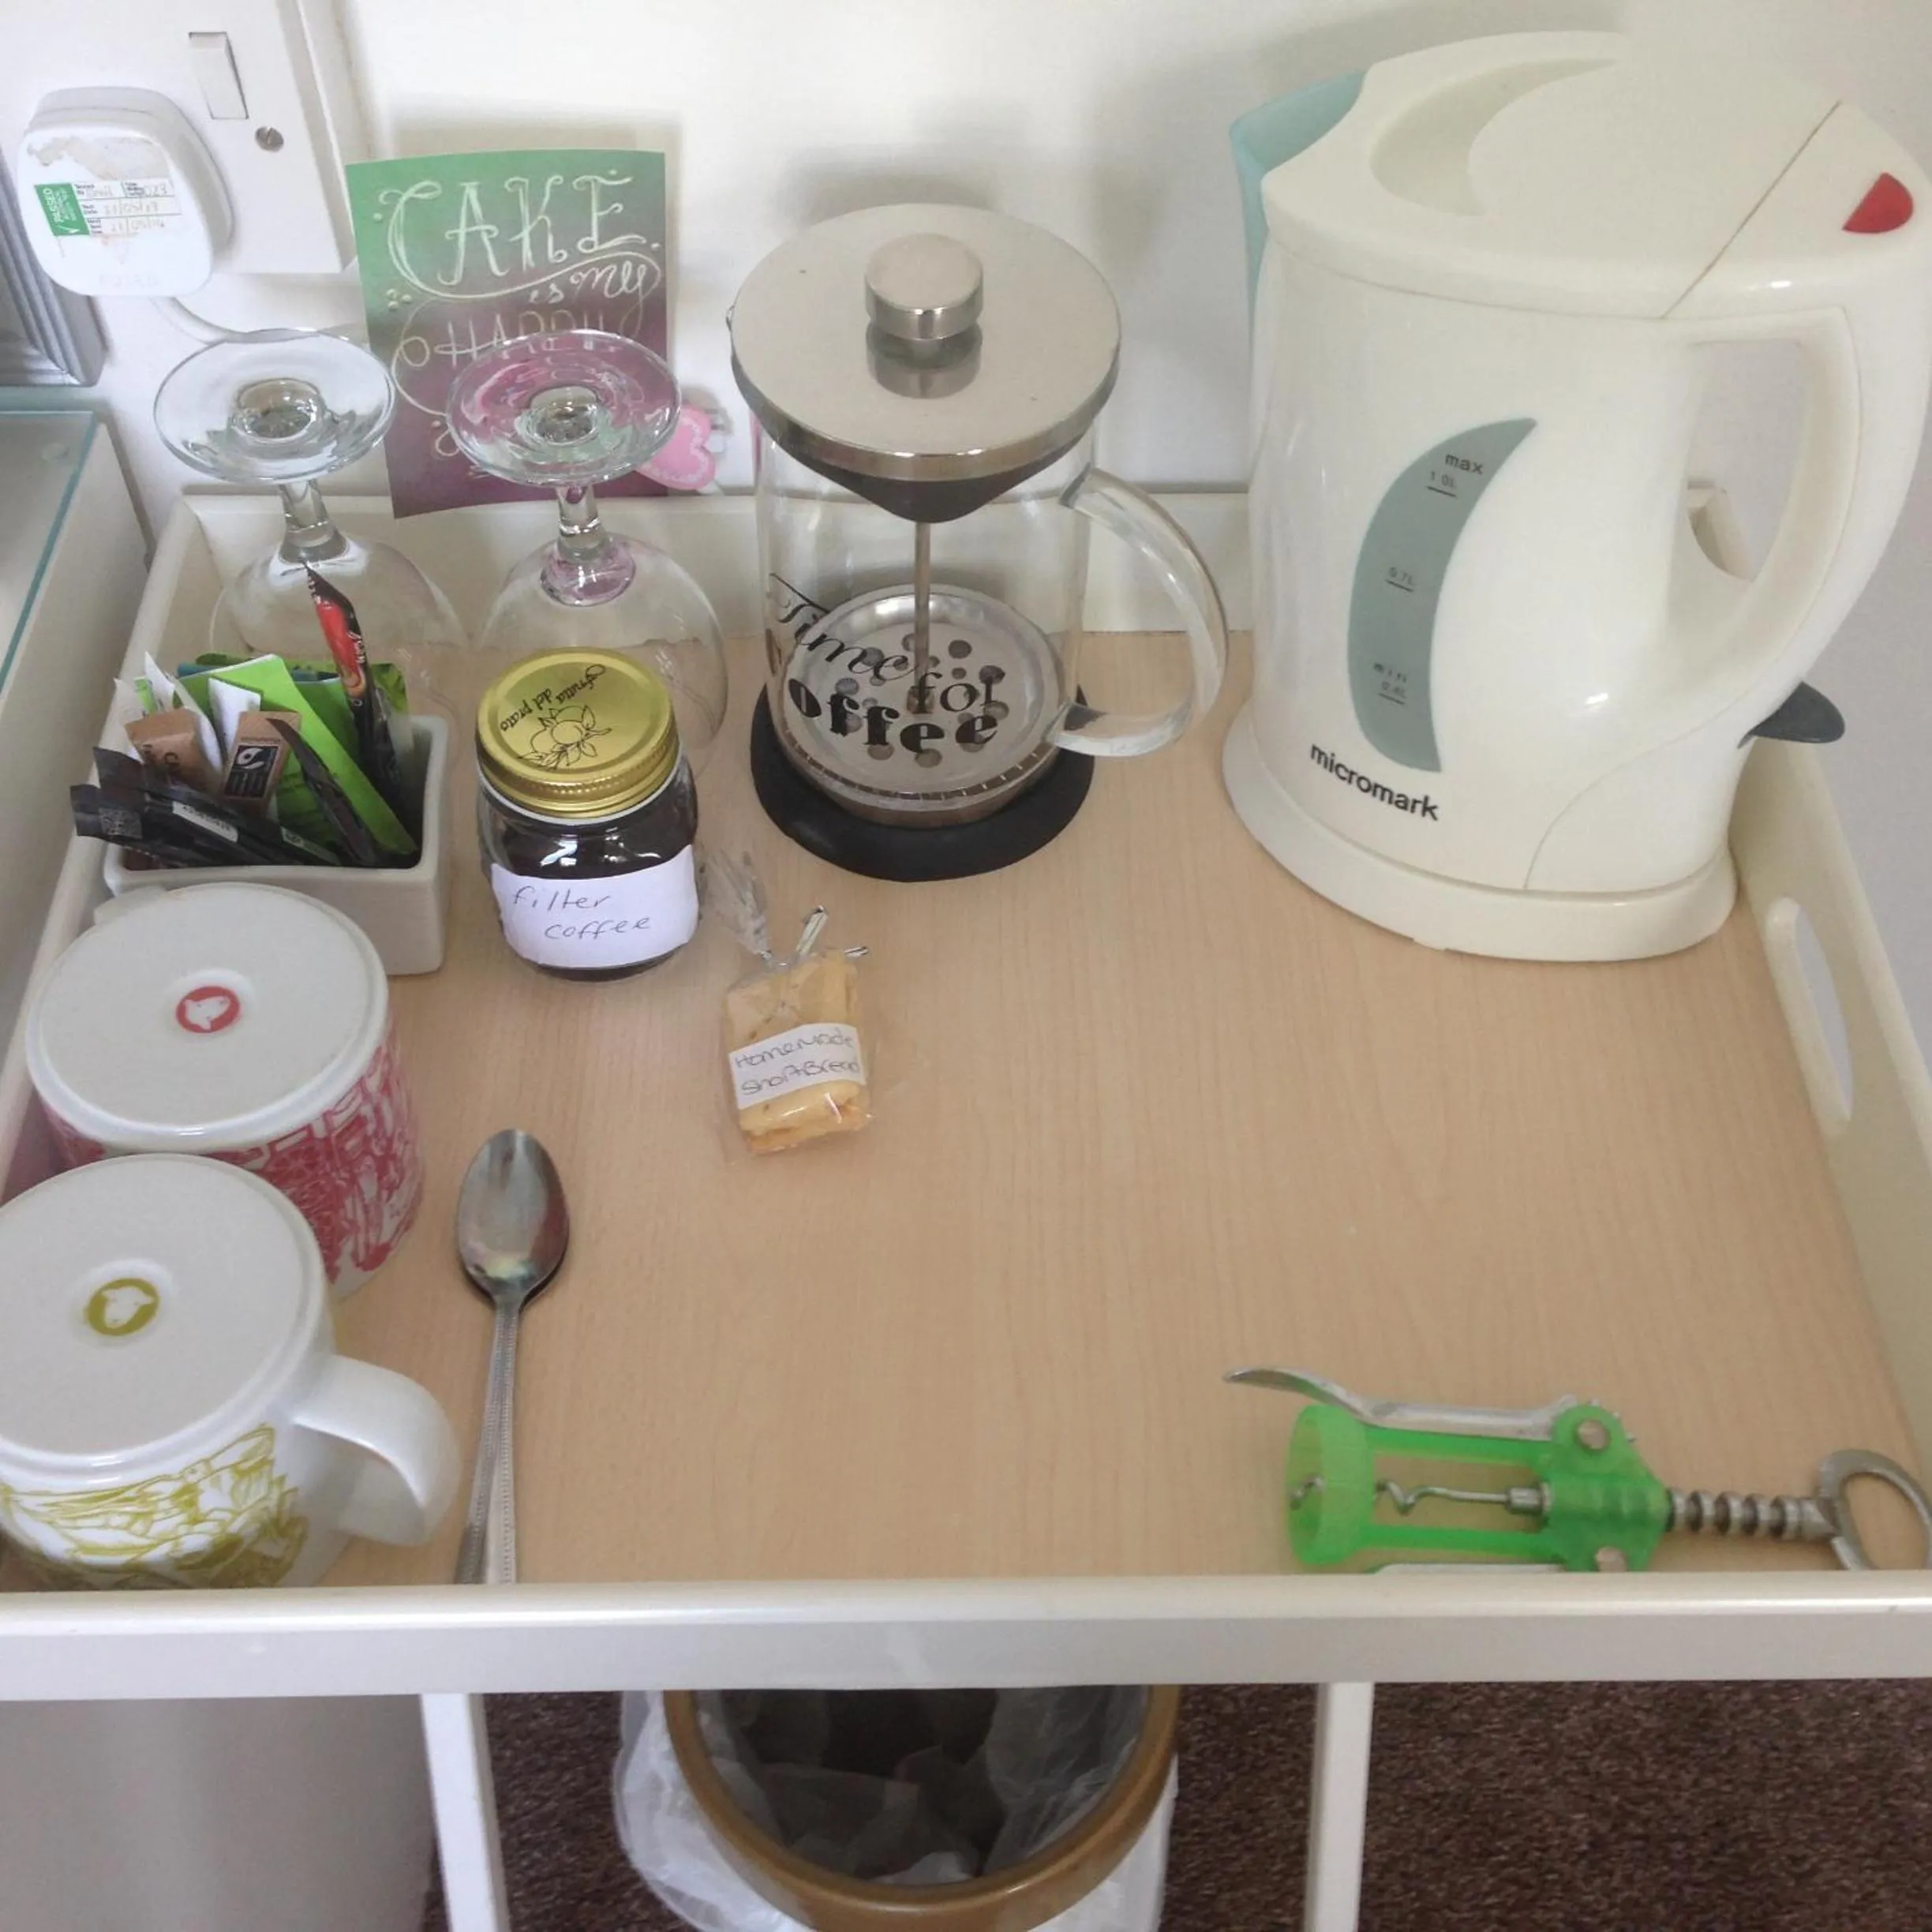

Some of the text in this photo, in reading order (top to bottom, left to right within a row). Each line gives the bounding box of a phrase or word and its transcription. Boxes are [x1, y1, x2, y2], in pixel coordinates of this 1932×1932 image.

[380, 174, 648, 297] CAKE
[569, 259, 649, 317] my
[1444, 454, 1485, 475] max
[1310, 743, 1439, 822] micromark
[512, 884, 612, 912] filter
[543, 914, 652, 941] coffee
